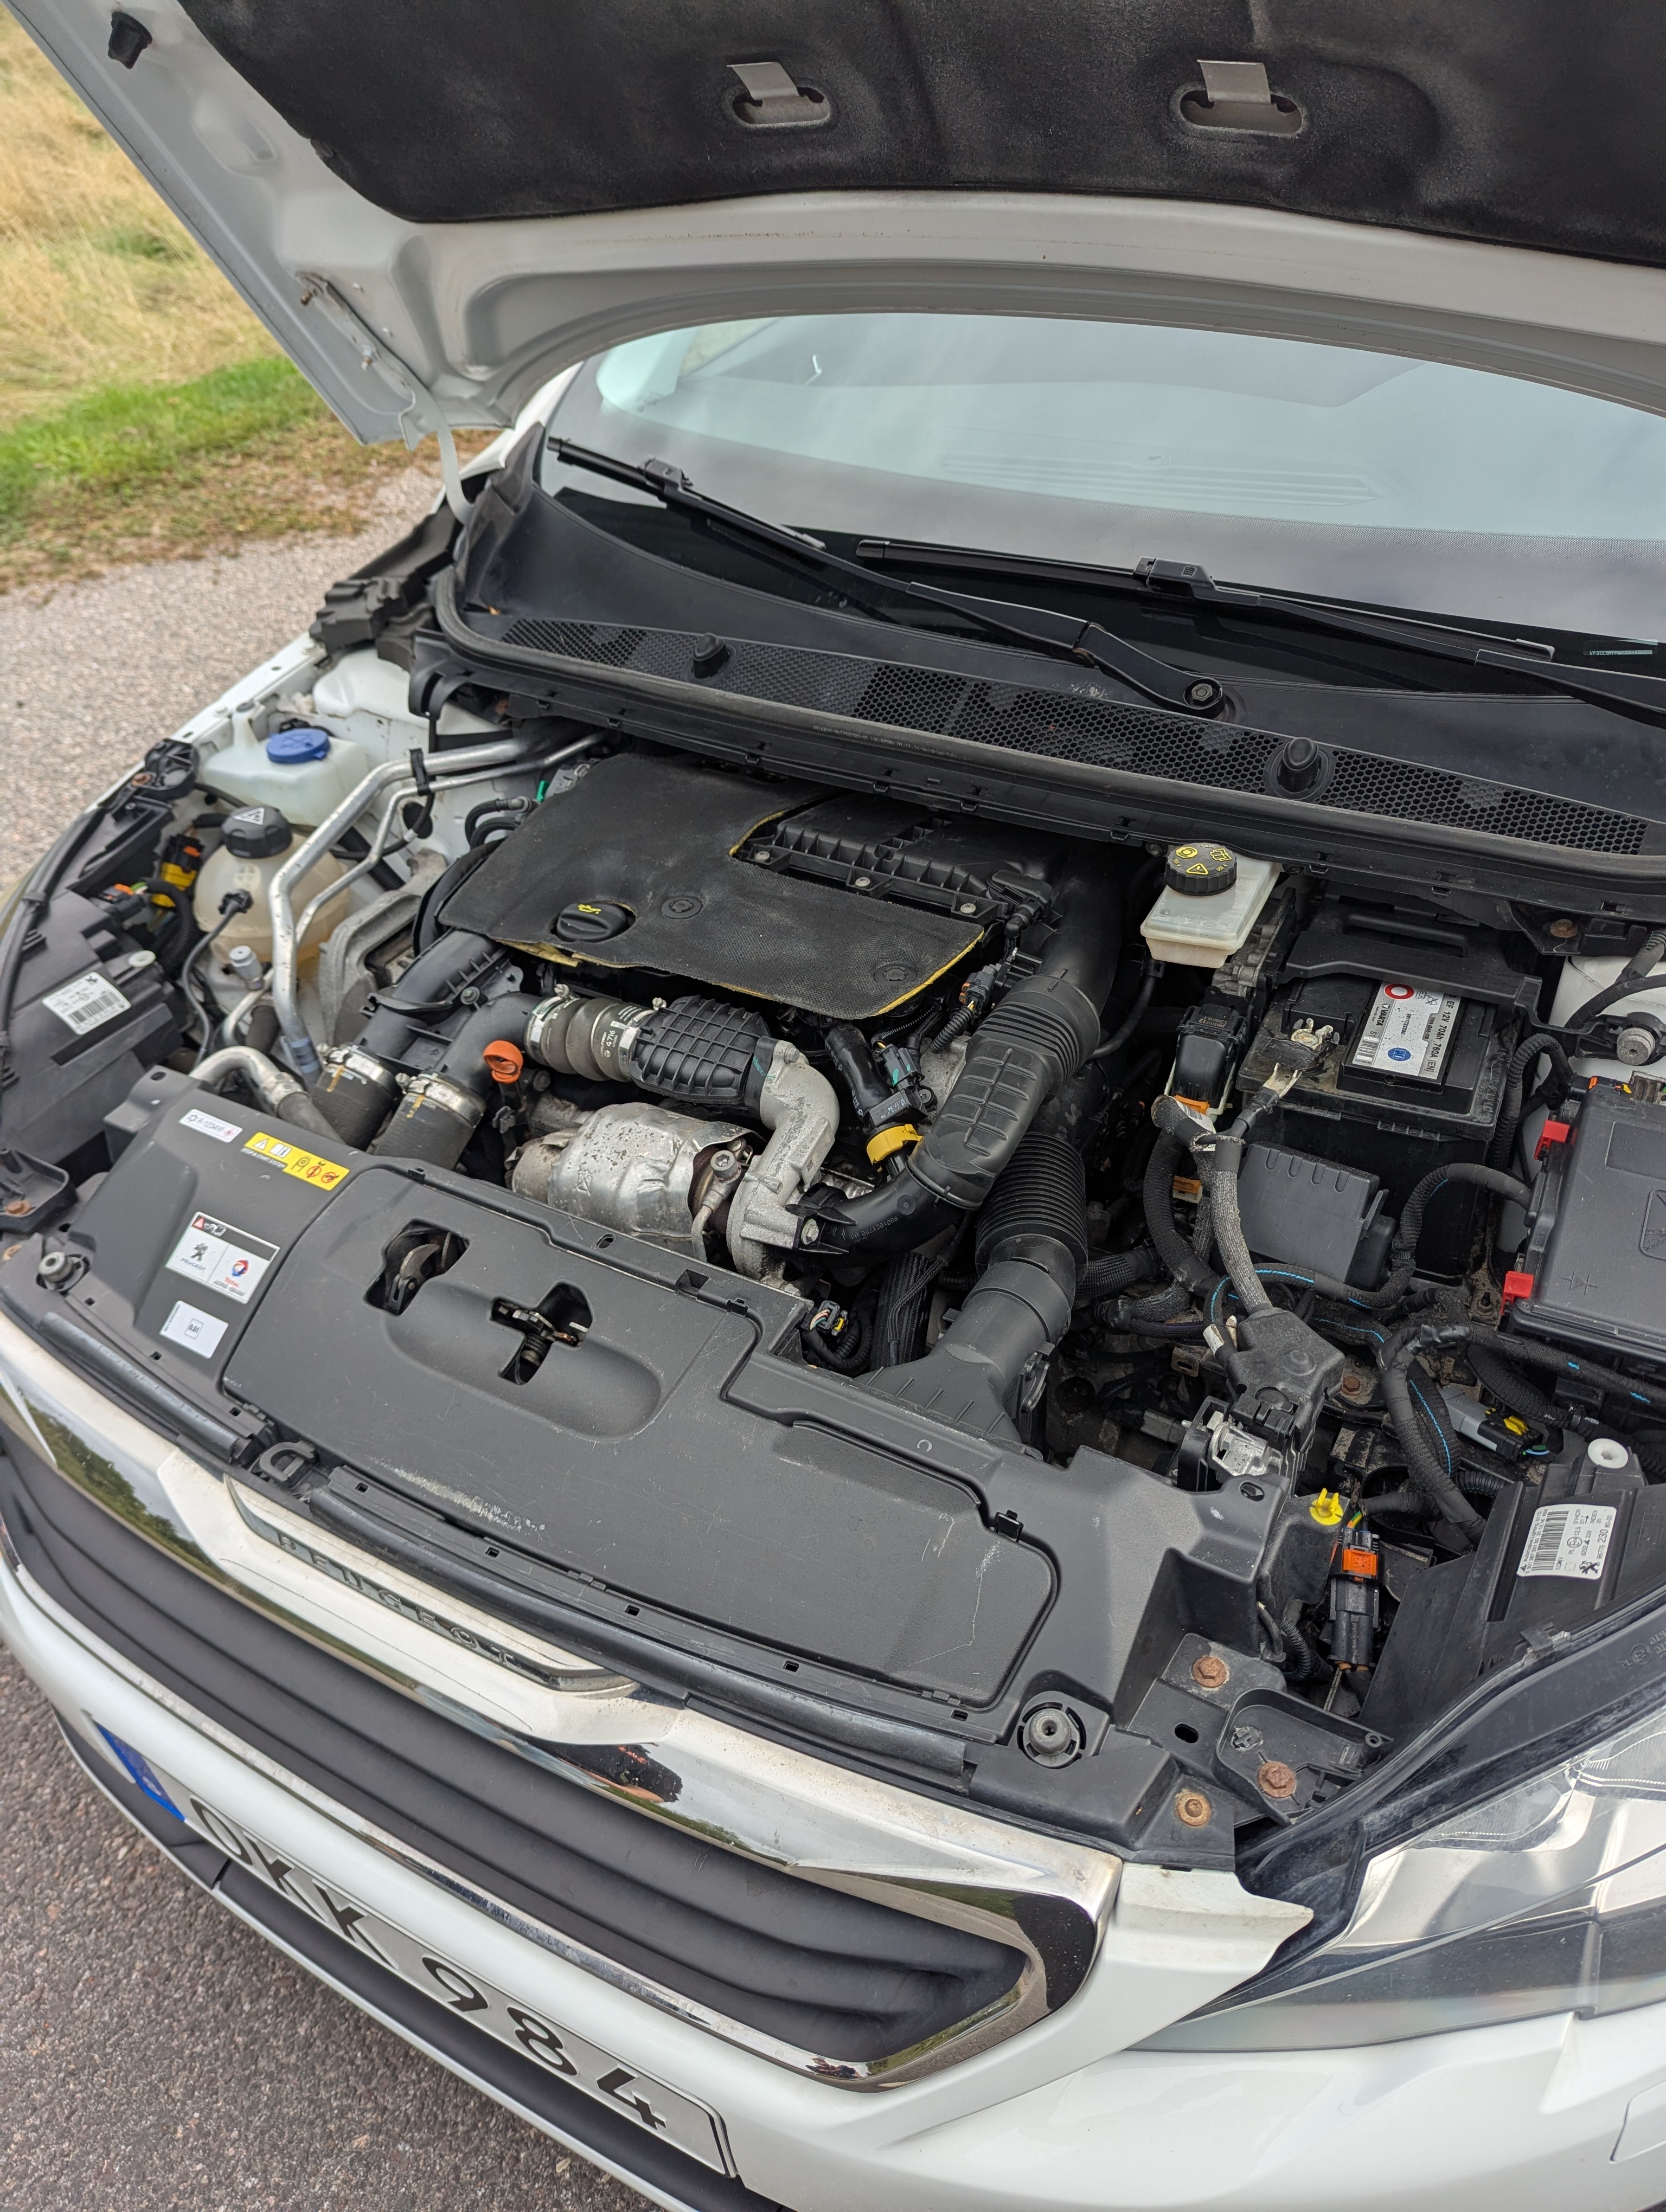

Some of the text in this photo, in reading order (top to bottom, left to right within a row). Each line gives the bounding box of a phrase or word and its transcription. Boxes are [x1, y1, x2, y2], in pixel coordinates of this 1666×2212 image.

[1446, 1001, 1455, 1009] EF
[1376, 1008, 1389, 1027] VARTA
[1441, 1012, 1451, 1023] 12V
[606, 1030, 616, 1047] 4716
[1435, 1024, 1447, 1041] 70Ah
[1430, 1043, 1441, 1059] 760A
[1424, 1060, 1437, 1073] (EN)
[181, 1257, 206, 1272] PEUGEOT
[223, 1276, 241, 1288] TOTAL
[1598, 1529, 1609, 1544] 230
[277, 1530, 515, 1666] PEUGEOT
[190, 1795, 667, 2130] OKK 984
